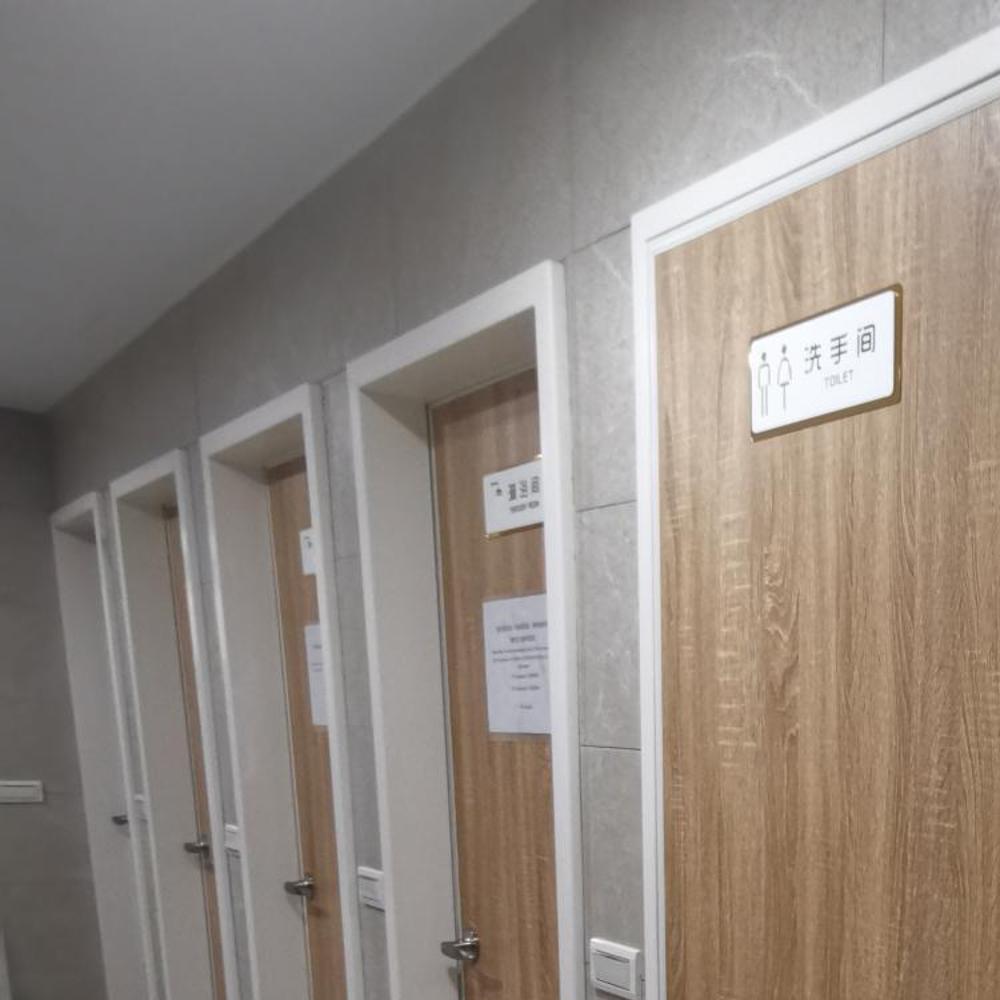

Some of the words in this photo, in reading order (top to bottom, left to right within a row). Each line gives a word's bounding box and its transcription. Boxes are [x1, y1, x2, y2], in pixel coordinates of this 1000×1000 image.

[804, 323, 876, 374] 洗手间
[824, 369, 854, 390] TOILET
